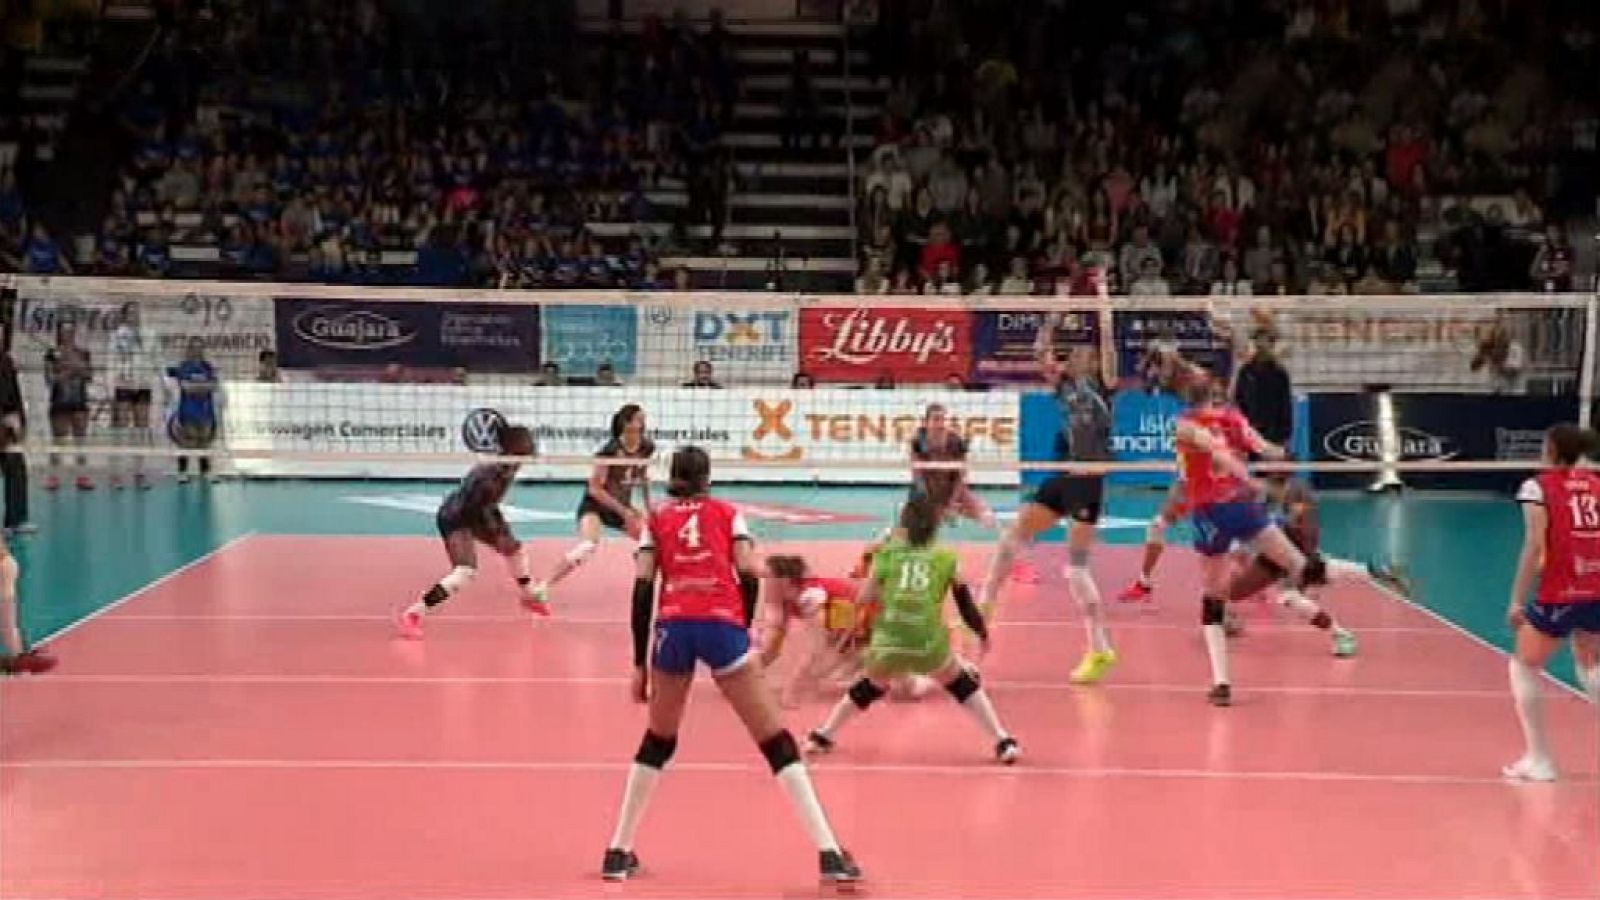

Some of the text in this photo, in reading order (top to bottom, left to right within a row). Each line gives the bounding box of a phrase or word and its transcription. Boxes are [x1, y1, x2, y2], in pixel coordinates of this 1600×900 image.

[312, 316, 401, 344] Guajara
[810, 302, 956, 365] Libby's
[1567, 493, 1600, 529] 13
[677, 512, 700, 549] 4
[898, 560, 930, 592] 18
